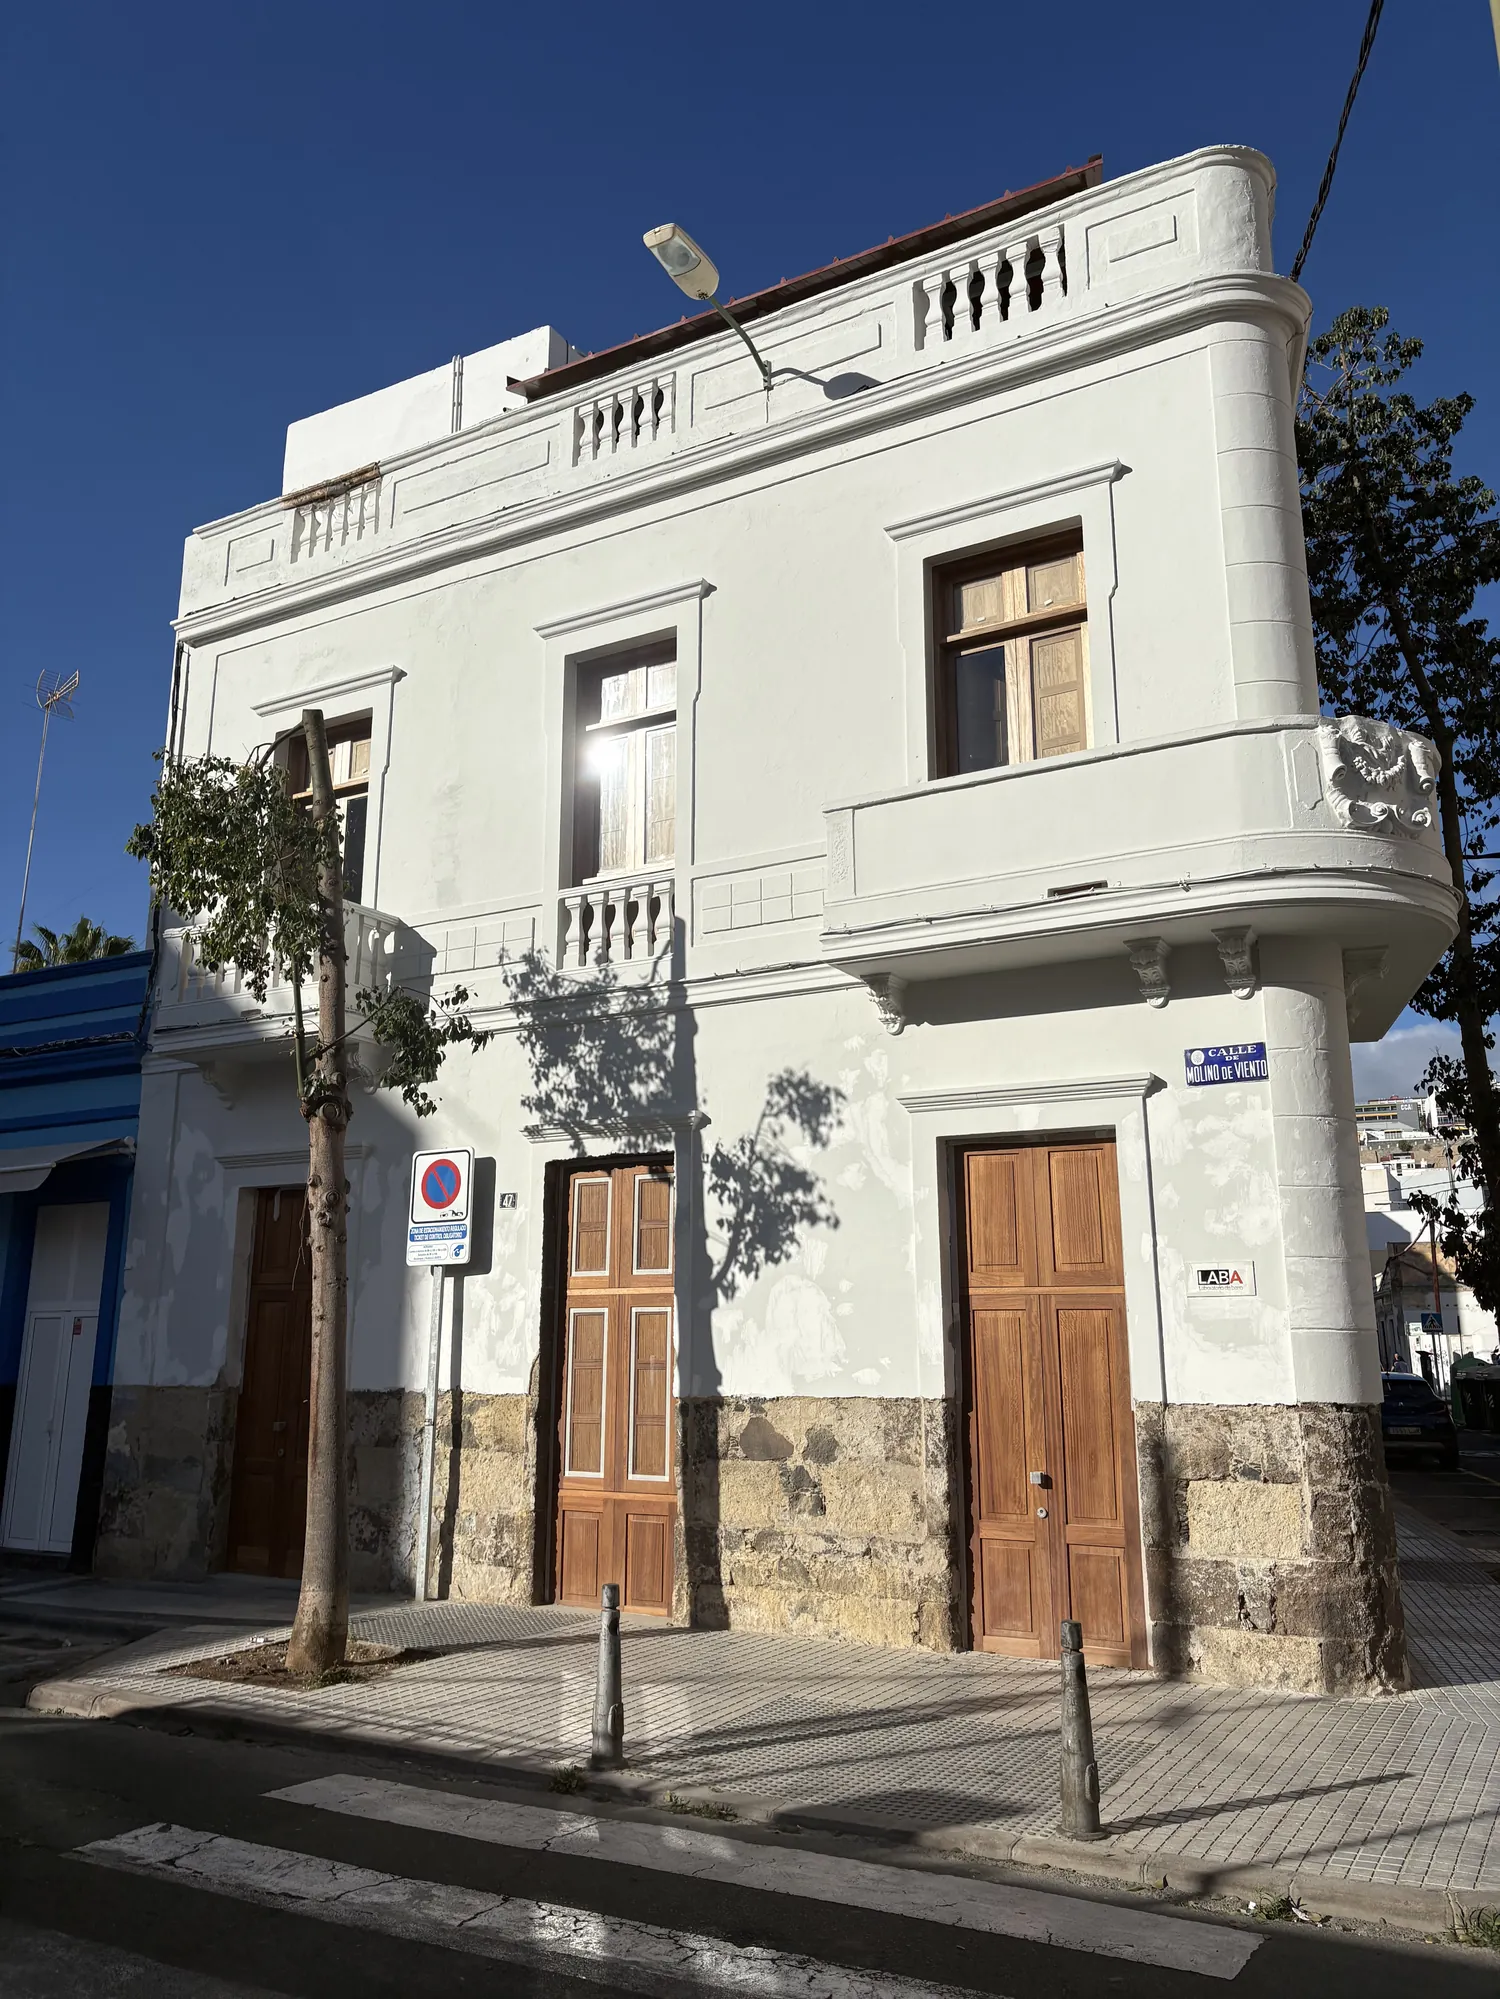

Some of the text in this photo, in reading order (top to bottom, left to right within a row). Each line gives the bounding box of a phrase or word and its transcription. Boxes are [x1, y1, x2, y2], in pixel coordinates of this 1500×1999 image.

[1208, 1045, 1257, 1057] CALLE
[1186, 1059, 1267, 1083] MOLINO DE VIENTO
[1198, 1270, 1243, 1284] LABA
